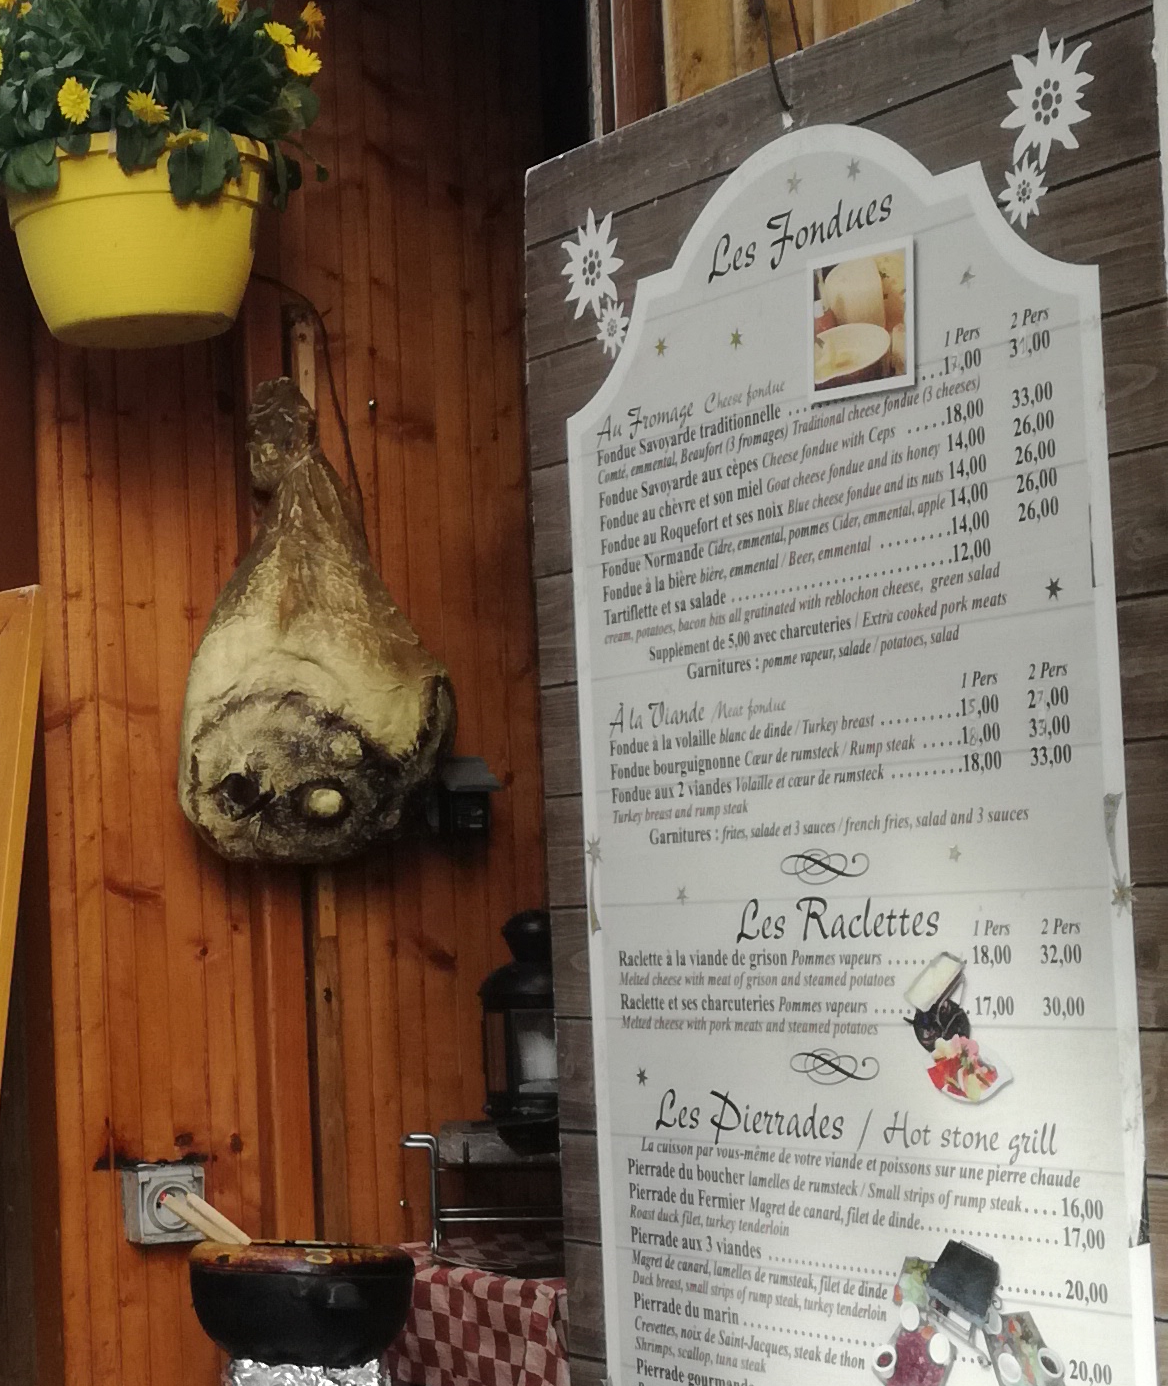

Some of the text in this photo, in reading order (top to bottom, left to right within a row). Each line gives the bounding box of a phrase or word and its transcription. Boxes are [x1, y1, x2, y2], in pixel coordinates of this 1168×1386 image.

[707, 191, 895, 285] Les Fondues
[1010, 307, 1050, 330] 2 Pers
[955, 326, 981, 346] Pers
[1011, 381, 1053, 409] 33,00
[628, 402, 694, 440] Fromage
[945, 398, 984, 425] 18,00
[1013, 409, 1055, 438] 26,00
[597, 403, 781, 466] Fondue Savoyarde traditionnelle
[947, 425, 986, 453] 14,00
[599, 457, 759, 509] Fondue Savoyarde aux cèpes
[660, 515, 719, 543] Roquefort
[644, 543, 705, 572] Normande
[953, 537, 991, 564] 12,00
[686, 657, 753, 682] Garnitures
[1030, 743, 1073, 769] 33,00
[736, 895, 942, 945] Les Raclettes
[619, 950, 665, 969] Raclette
[971, 943, 1013, 968] 18,00
[1039, 942, 1083, 967] 32,00
[974, 994, 1016, 1018] 17,00
[1042, 994, 1086, 1019] 30,00
[655, 1088, 701, 1133] Les
[710, 1089, 845, 1146] Pierrades
[883, 1112, 933, 1151] Hot
[940, 1126, 1001, 1153] stone
[1007, 1122, 1060, 1168] grill
[1061, 1196, 1105, 1221] 16,00
[1063, 1226, 1107, 1251] 17,00
[1065, 1279, 1109, 1305] 20,00
